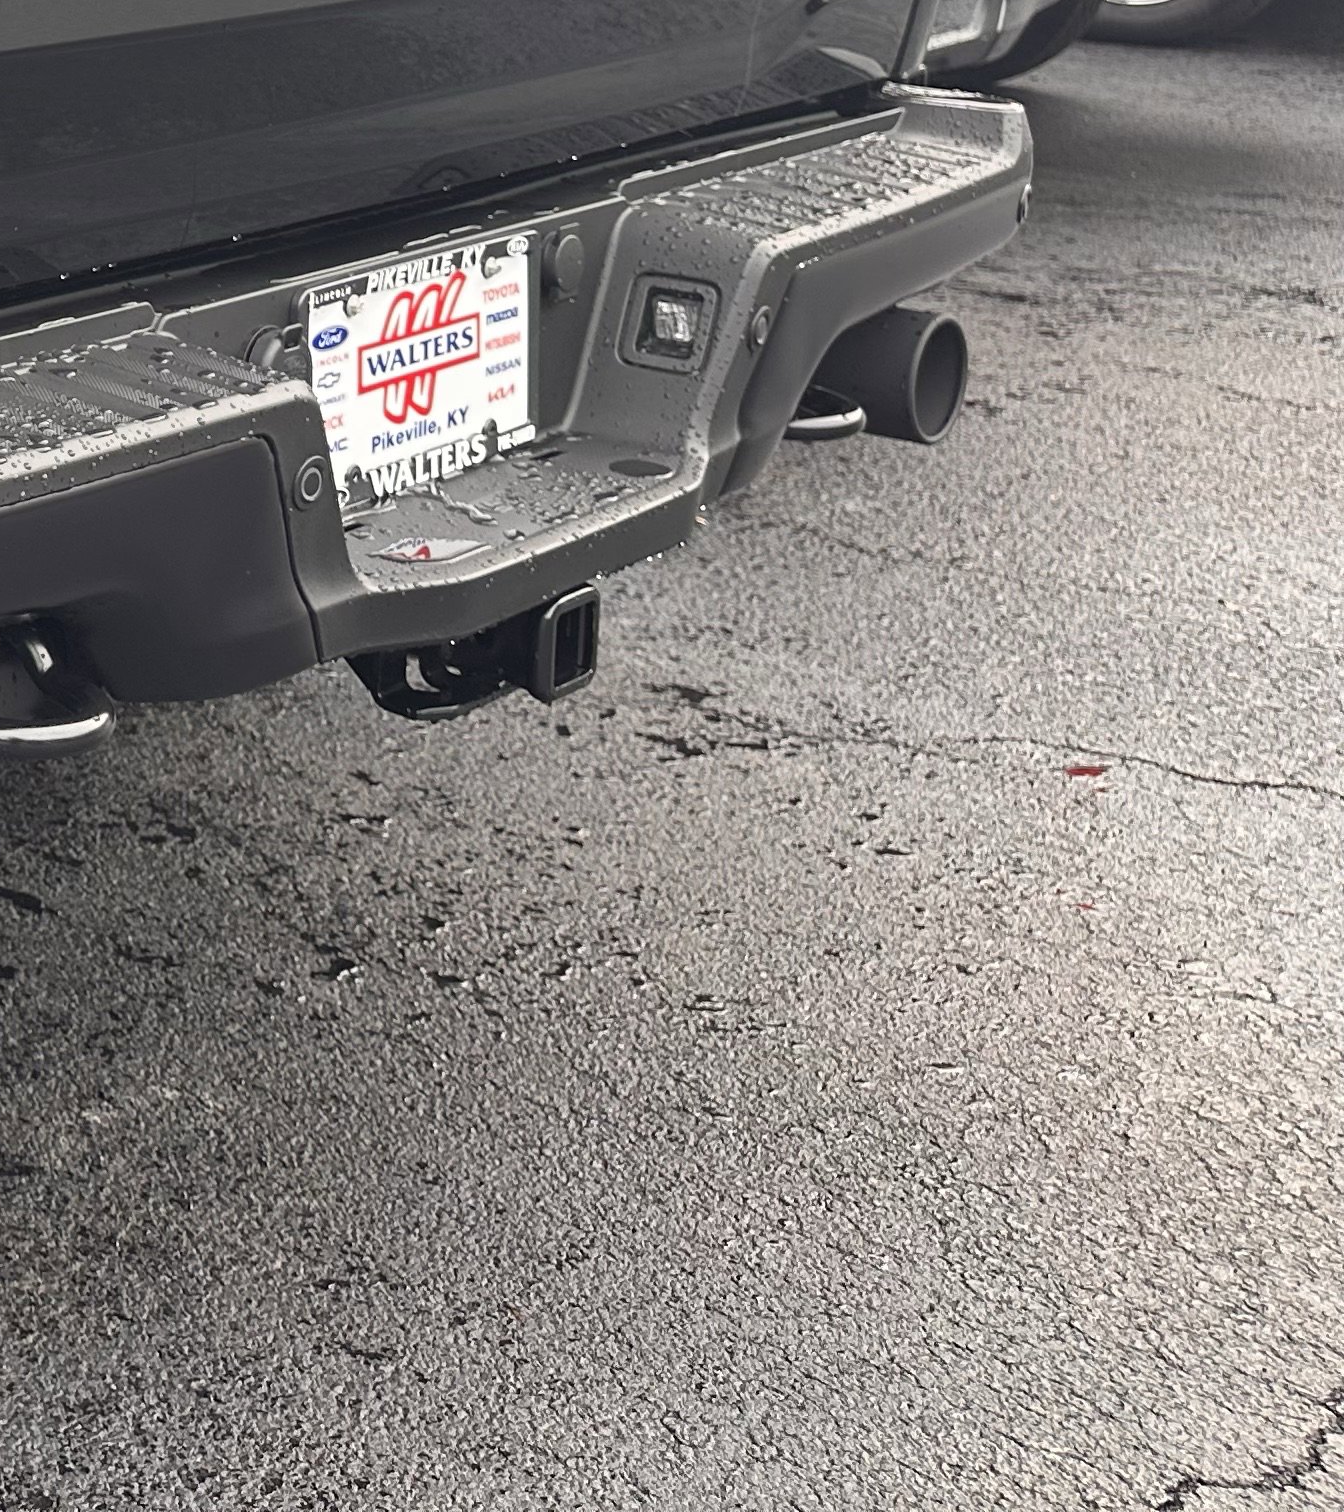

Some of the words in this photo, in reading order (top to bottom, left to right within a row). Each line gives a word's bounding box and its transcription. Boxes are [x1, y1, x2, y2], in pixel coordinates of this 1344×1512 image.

[461, 243, 486, 269] KY
[483, 282, 520, 304] TOYOTA
[315, 327, 346, 349] Ford
[366, 326, 475, 378] WALTERS
[485, 357, 522, 376] NISSAN
[372, 419, 442, 453] Pikeville,
[447, 405, 470, 428] KY
[369, 435, 487, 497] WALTERS
